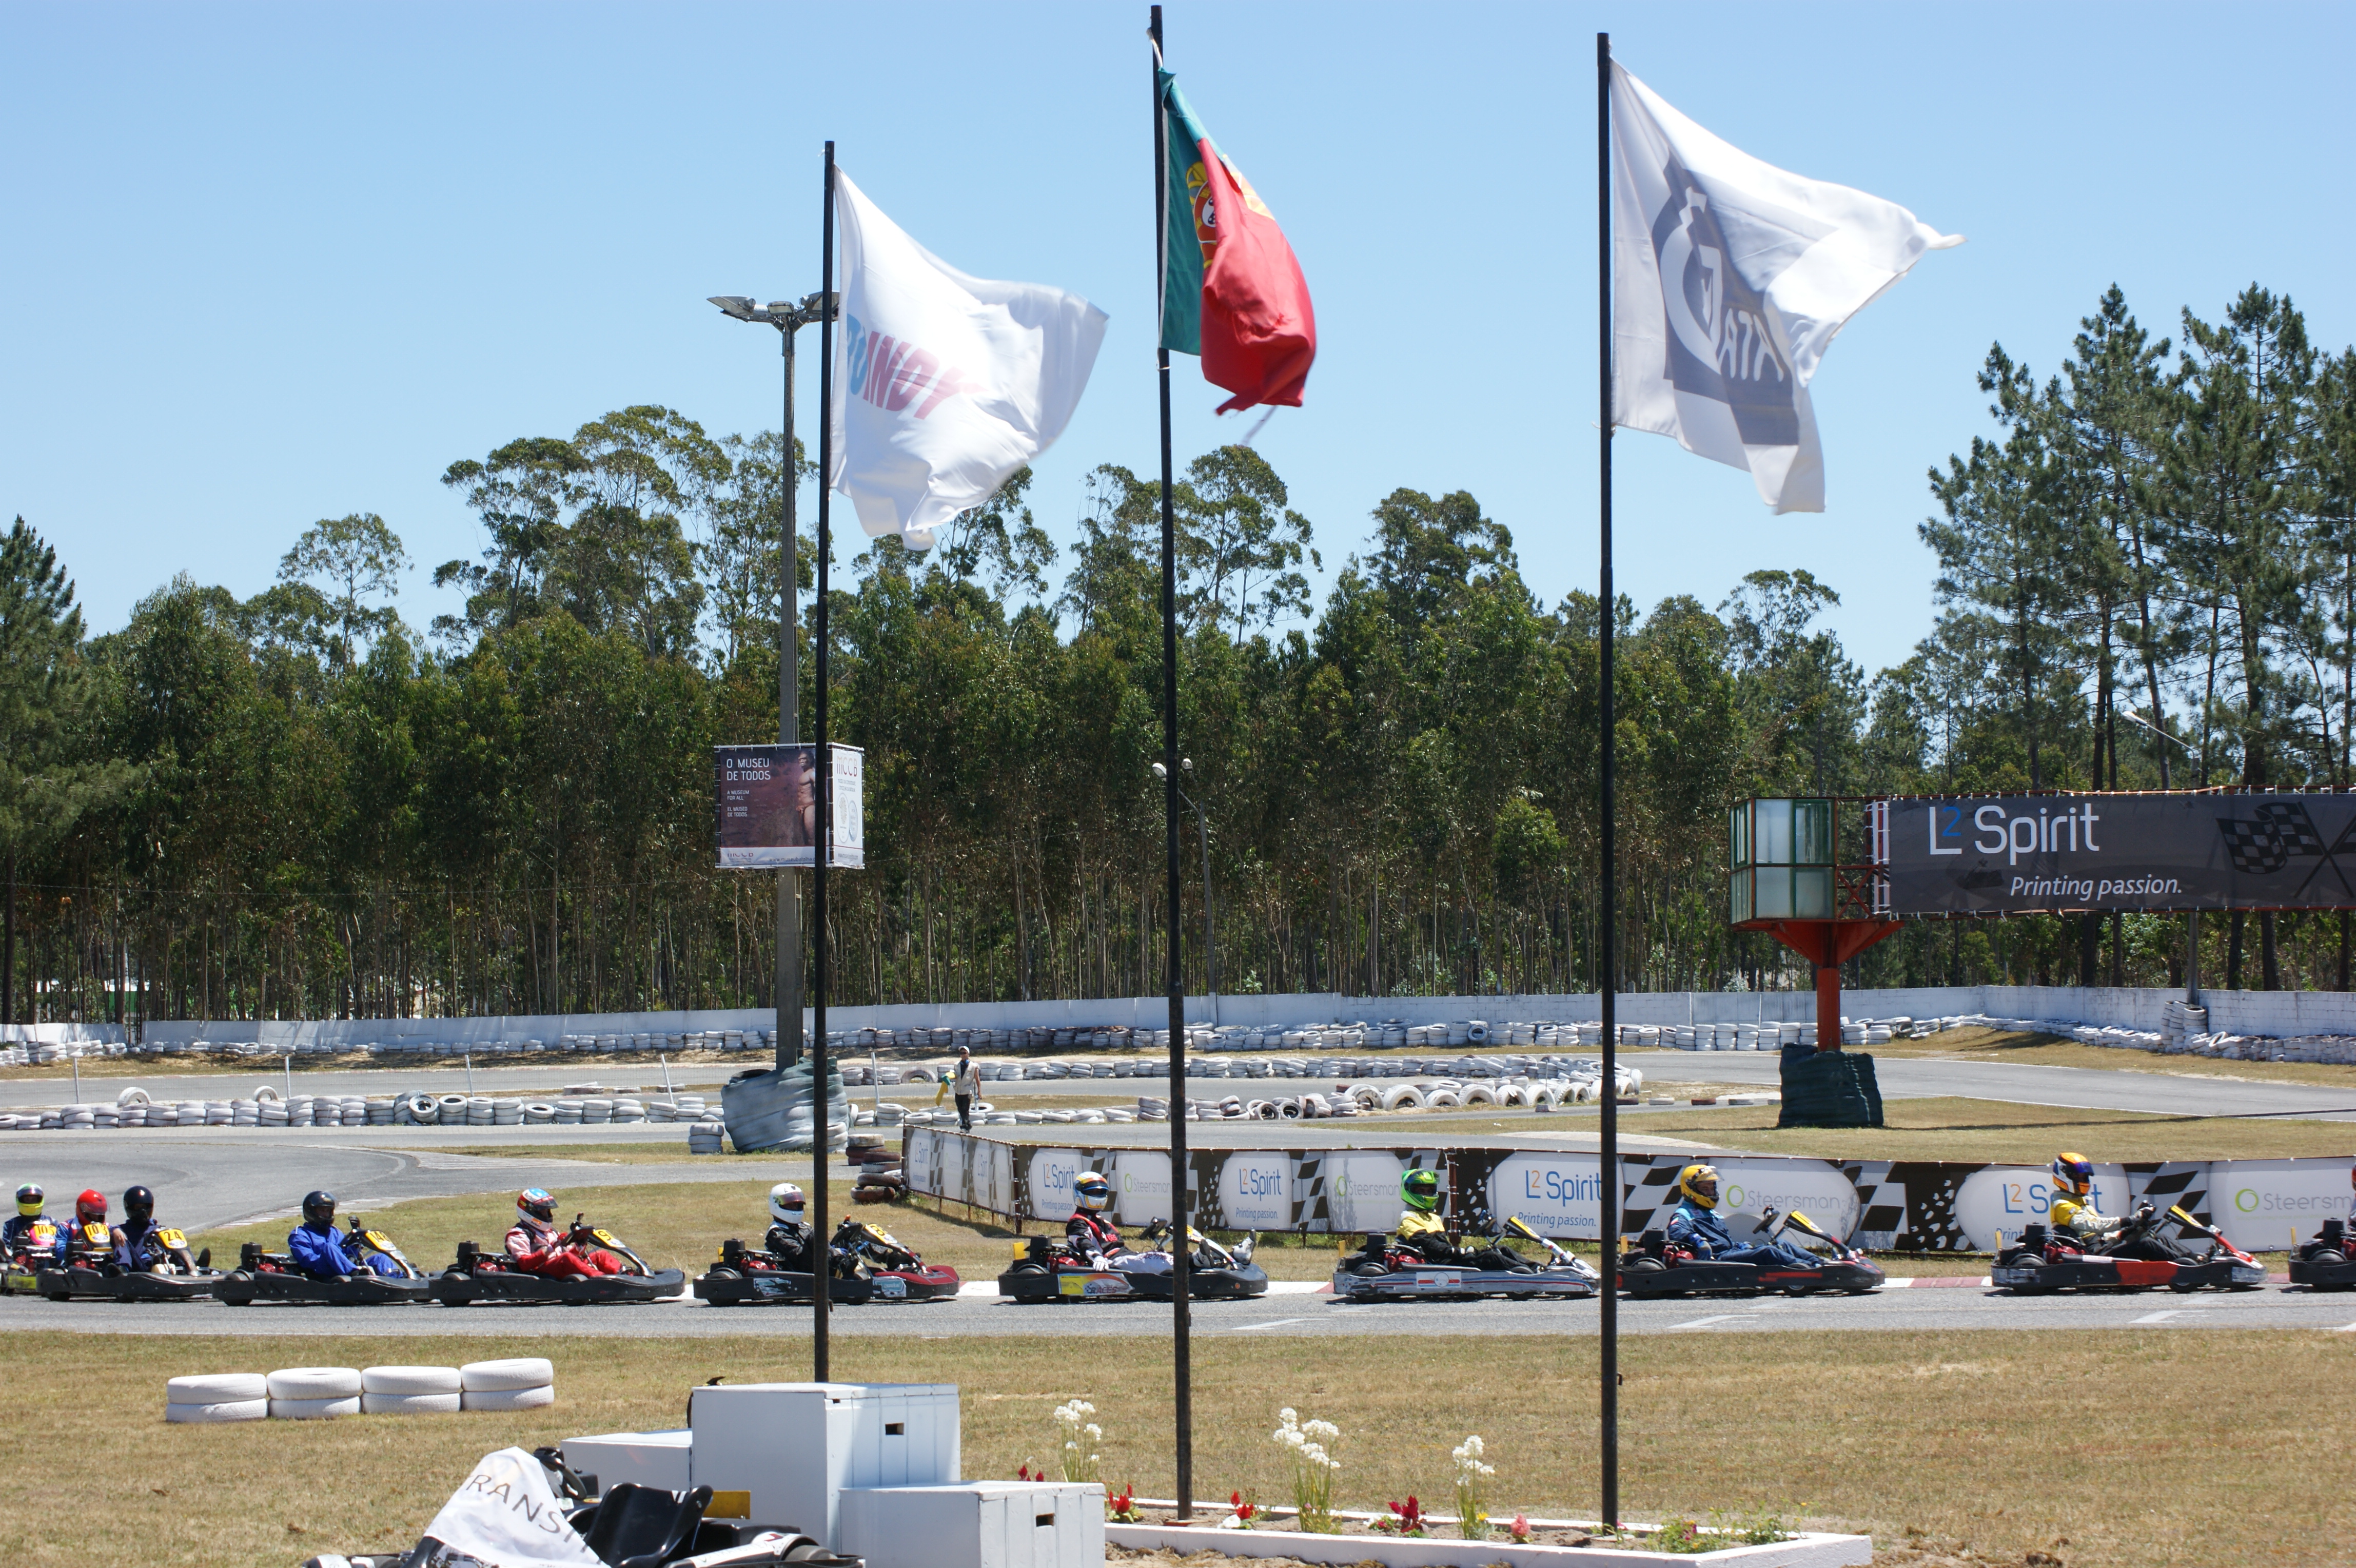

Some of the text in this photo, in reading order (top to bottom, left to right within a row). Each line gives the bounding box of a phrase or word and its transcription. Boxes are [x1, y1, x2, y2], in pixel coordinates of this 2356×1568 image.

[727, 758, 770, 768] O MUSEU
[727, 771, 771, 780] DE TODOS
[2010, 874, 2183, 901] Printing passion.
[1348, 1180, 1401, 1196] Steersman
[1042, 1199, 1057, 1212] Printing
[1748, 1190, 1840, 1209] Steersman
[2264, 1193, 2351, 1210] Steersm
[1235, 1207, 1278, 1222] Printing passion.
[1518, 1212, 1596, 1228] Printing passion.
[37, 1225, 54, 1236] 105
[87, 1225, 108, 1236] 103
[164, 1231, 182, 1241] 24
